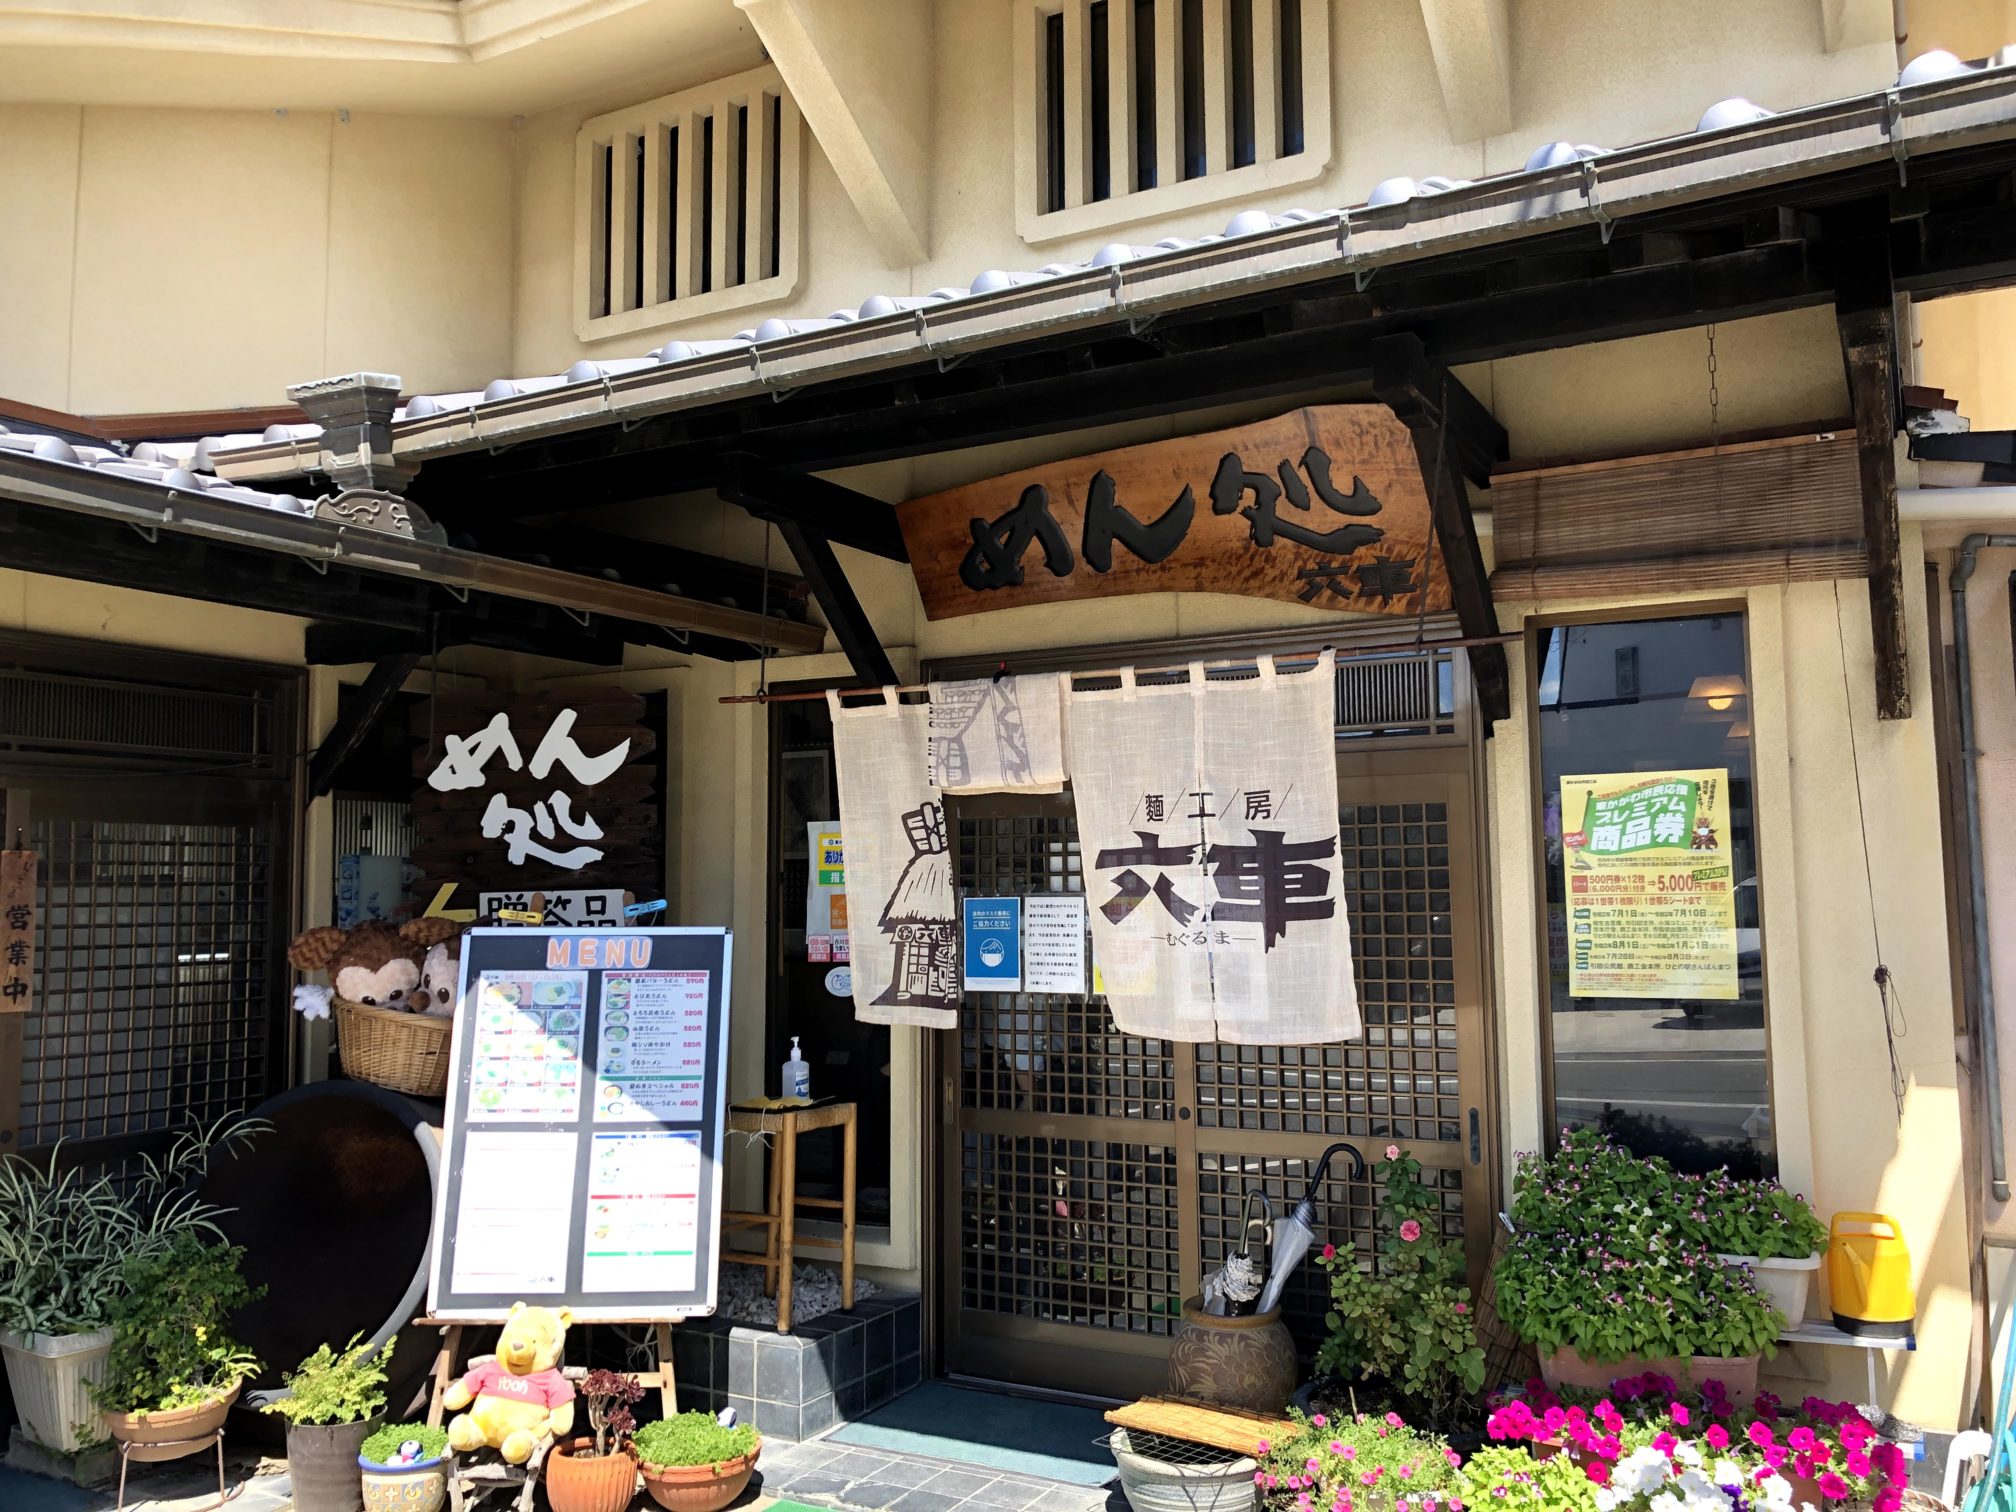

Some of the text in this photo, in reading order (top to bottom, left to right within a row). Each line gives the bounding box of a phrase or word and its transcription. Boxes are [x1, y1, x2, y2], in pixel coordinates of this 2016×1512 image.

[957, 445, 1386, 592] めん処
[1299, 554, 1421, 609] 六車
[427, 708, 632, 793] めん
[480, 790, 605, 871] 処
[1590, 812, 1686, 851] 商品券
[1595, 796, 1687, 825] プレミアム
[1094, 828, 1338, 955] 六車
[1589, 874, 1646, 885] 500円券×12枚
[972, 920, 1011, 928] ご協力ください
[1165, 930, 1231, 947] むぐるま
[2, 903, 33, 1006] 営業中
[547, 936, 653, 968] MENU
